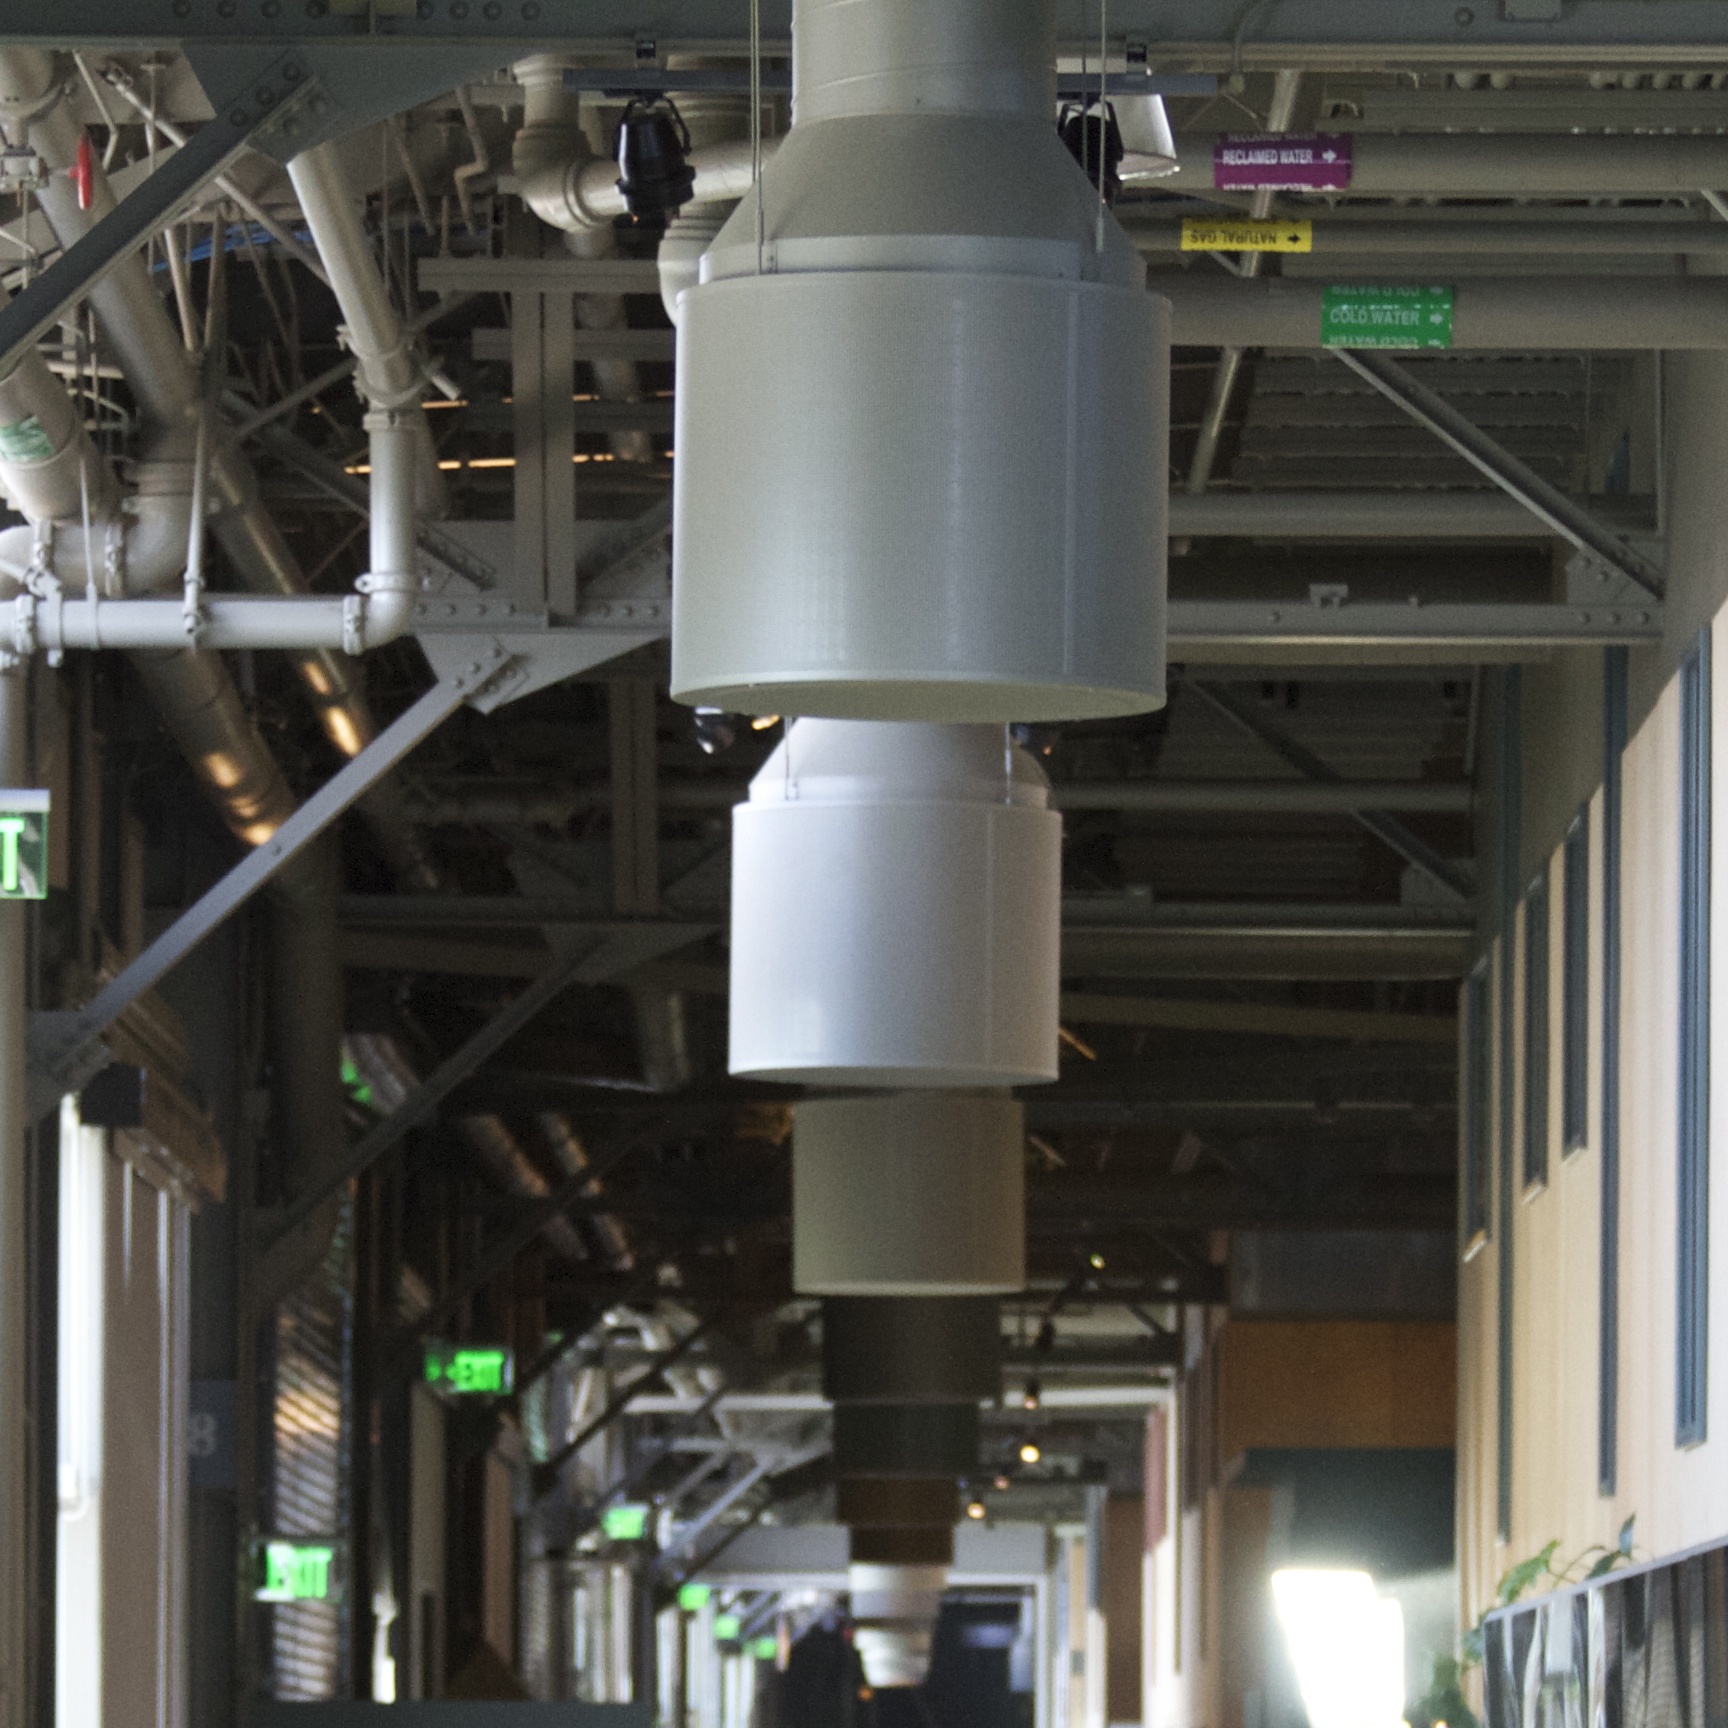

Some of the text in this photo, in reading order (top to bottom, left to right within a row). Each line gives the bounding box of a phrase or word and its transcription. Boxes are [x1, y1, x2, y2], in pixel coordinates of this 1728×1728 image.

[1222, 149, 1313, 165] RECLAIMED WATER
[1330, 307, 1419, 325] COLD WATER
